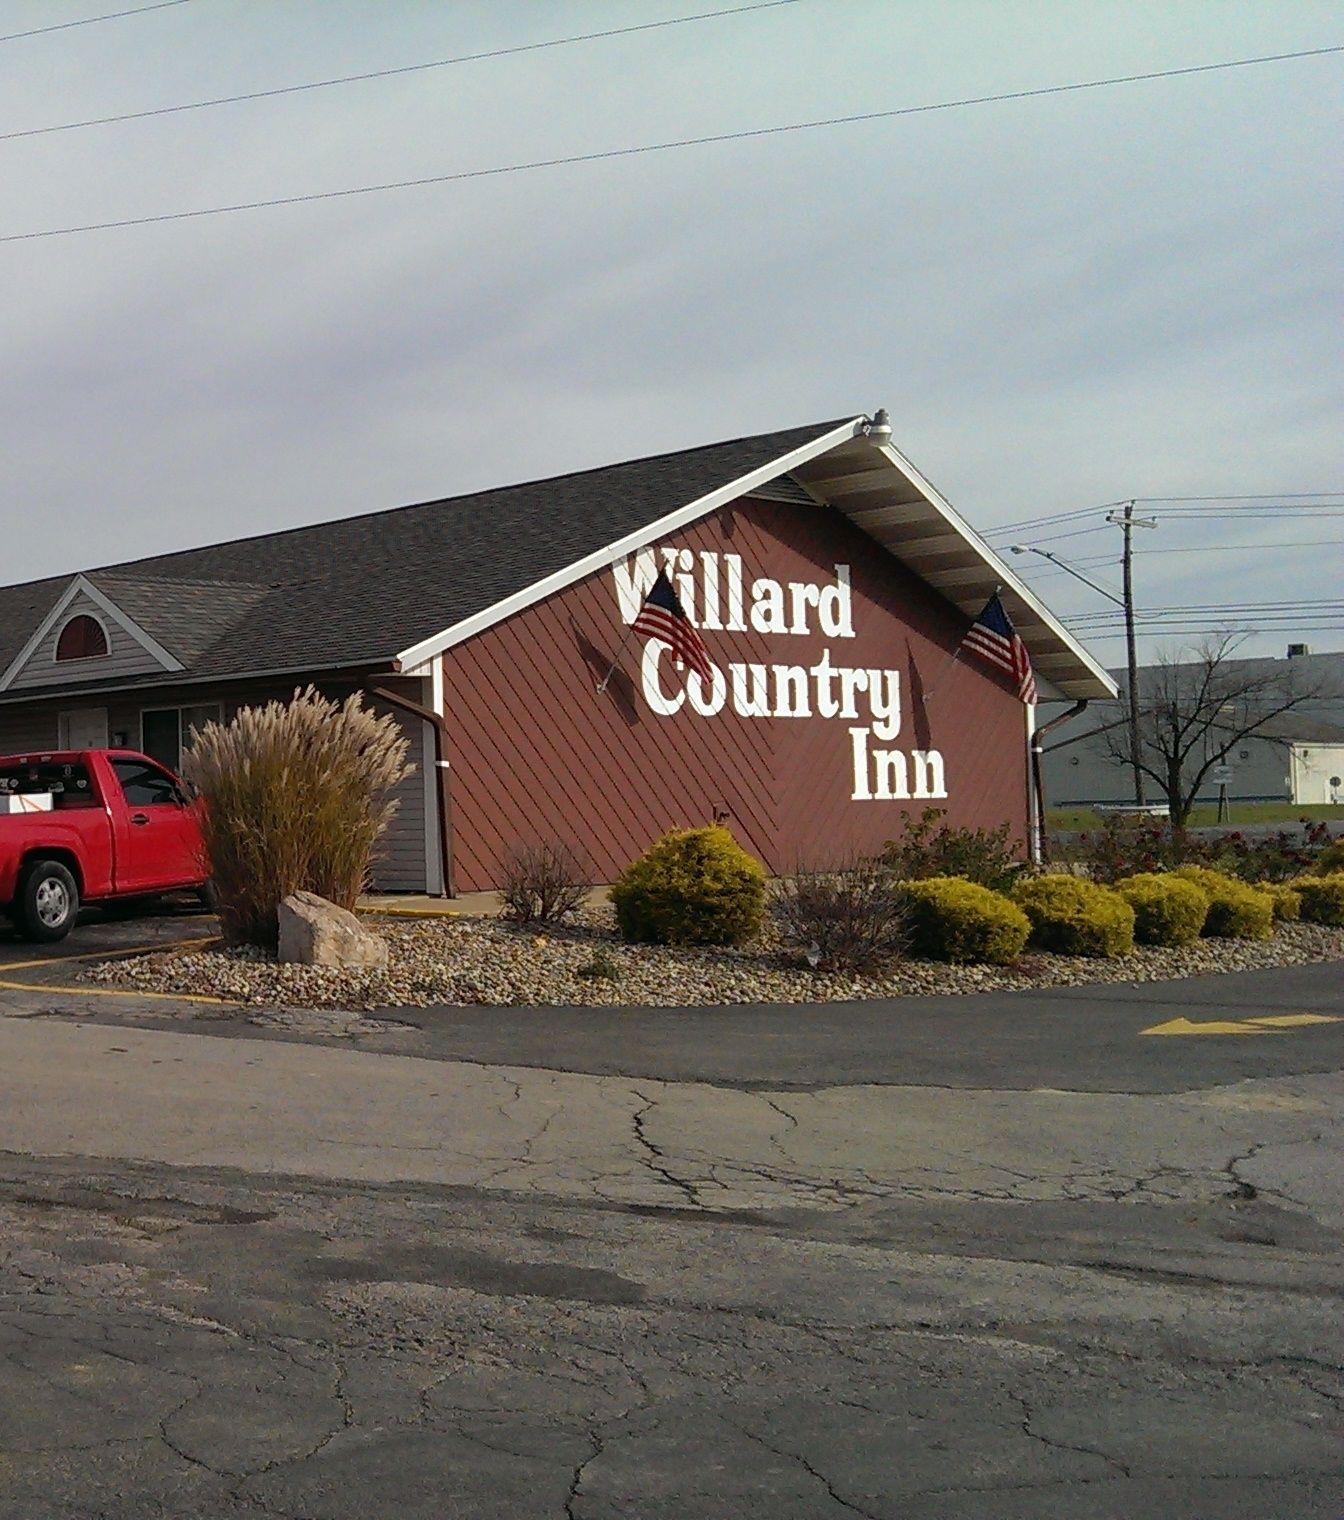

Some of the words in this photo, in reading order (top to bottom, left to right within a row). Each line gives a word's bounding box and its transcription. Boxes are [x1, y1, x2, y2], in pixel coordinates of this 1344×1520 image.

[612, 546, 855, 638] Willard
[641, 636, 902, 741] Country
[849, 727, 948, 800] Inn
